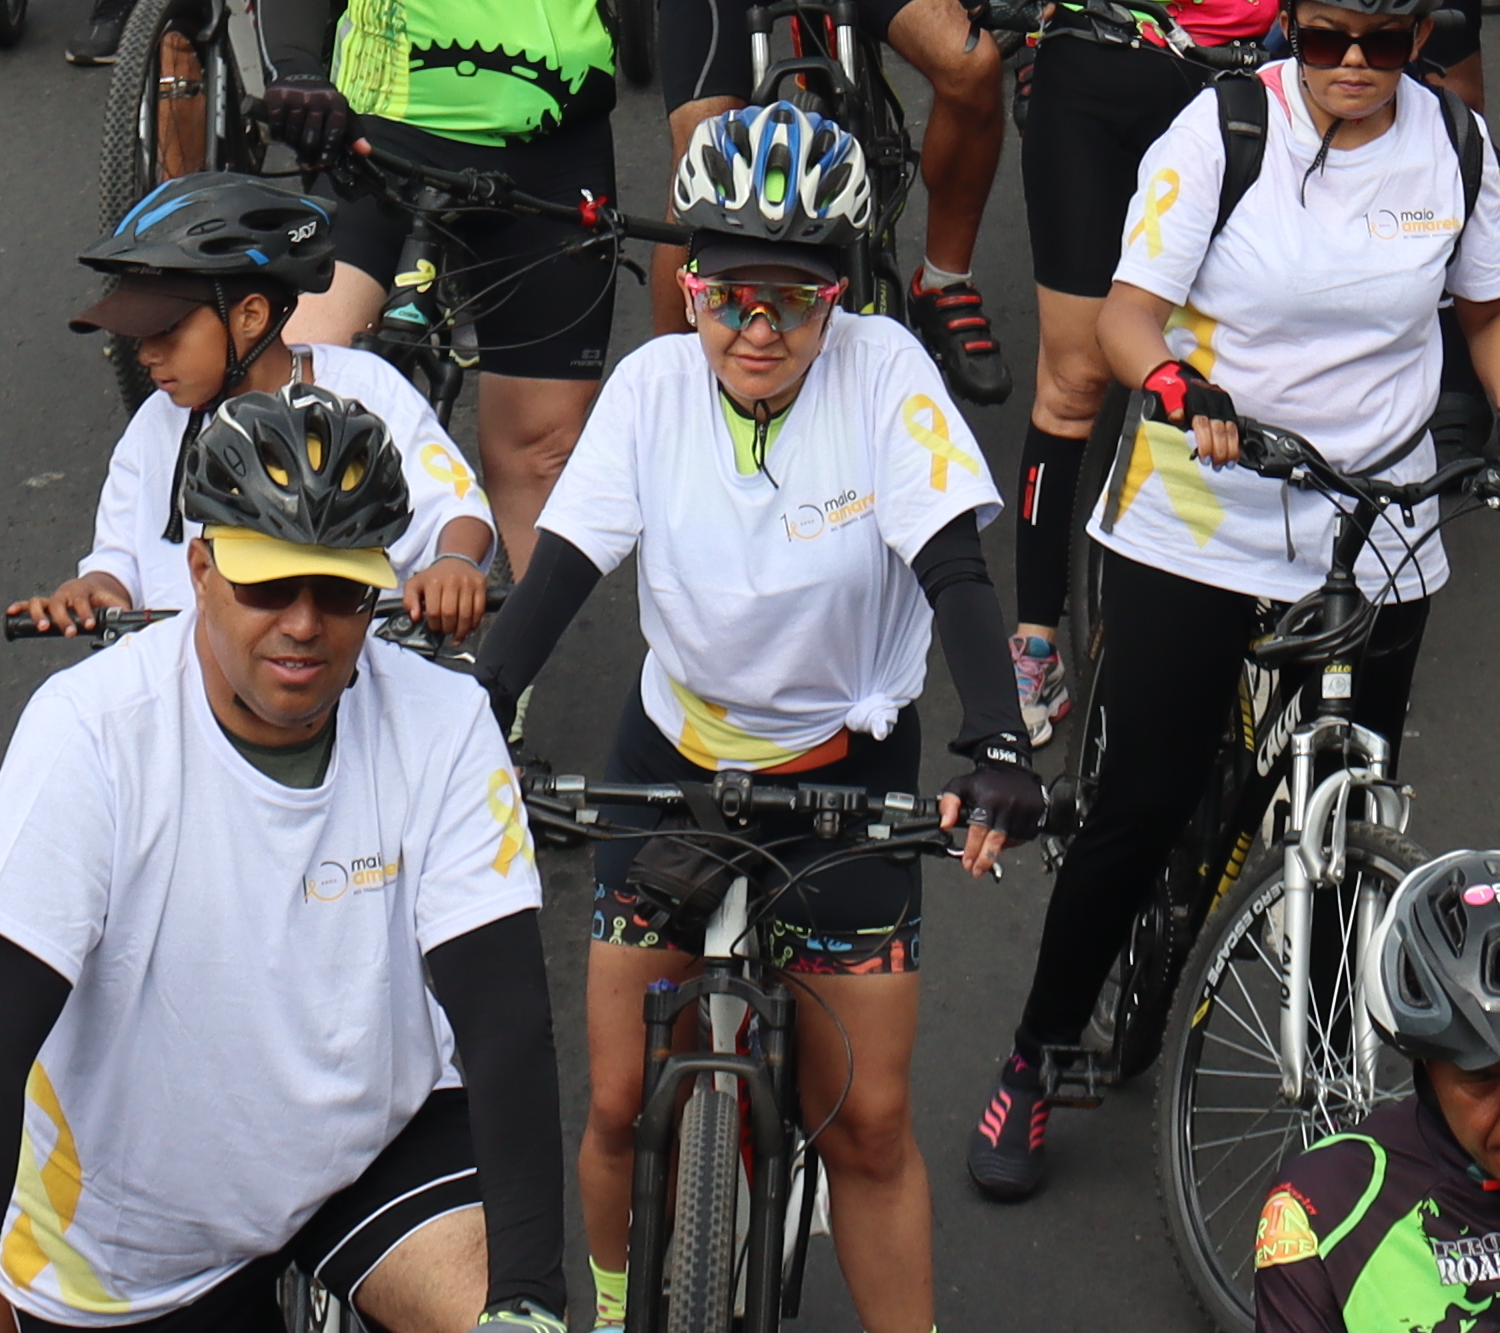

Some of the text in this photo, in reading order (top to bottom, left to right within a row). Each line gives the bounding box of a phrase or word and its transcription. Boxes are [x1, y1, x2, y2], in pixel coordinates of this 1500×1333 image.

[1400, 207, 1435, 220] maio
[824, 489, 858, 513] maio
[1206, 919, 1255, 987] ESCAPE
